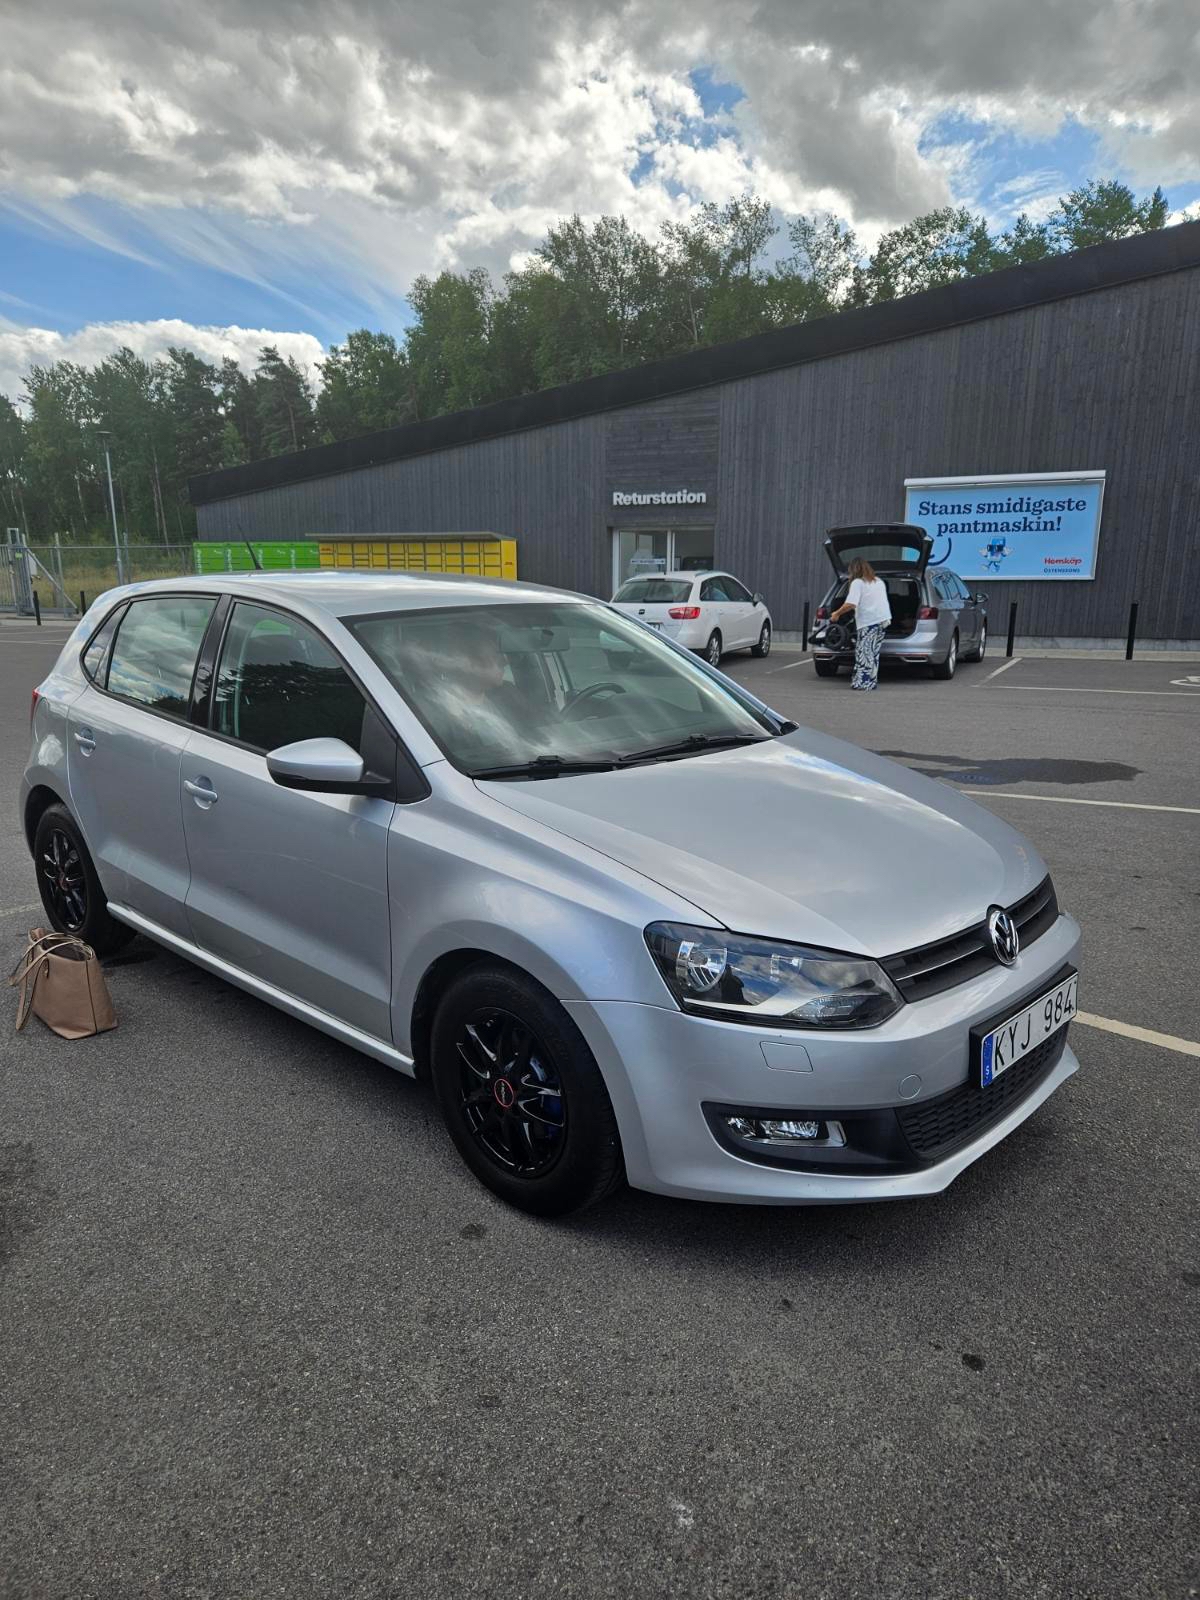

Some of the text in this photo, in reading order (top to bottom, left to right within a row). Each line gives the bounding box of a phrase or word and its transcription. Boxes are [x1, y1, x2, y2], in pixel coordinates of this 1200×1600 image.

[613, 489, 706, 505] Returstation
[918, 497, 1087, 516] Stans smidigaste
[936, 516, 1062, 536] pantmaskin!
[994, 983, 1074, 1071] KYJ 984
